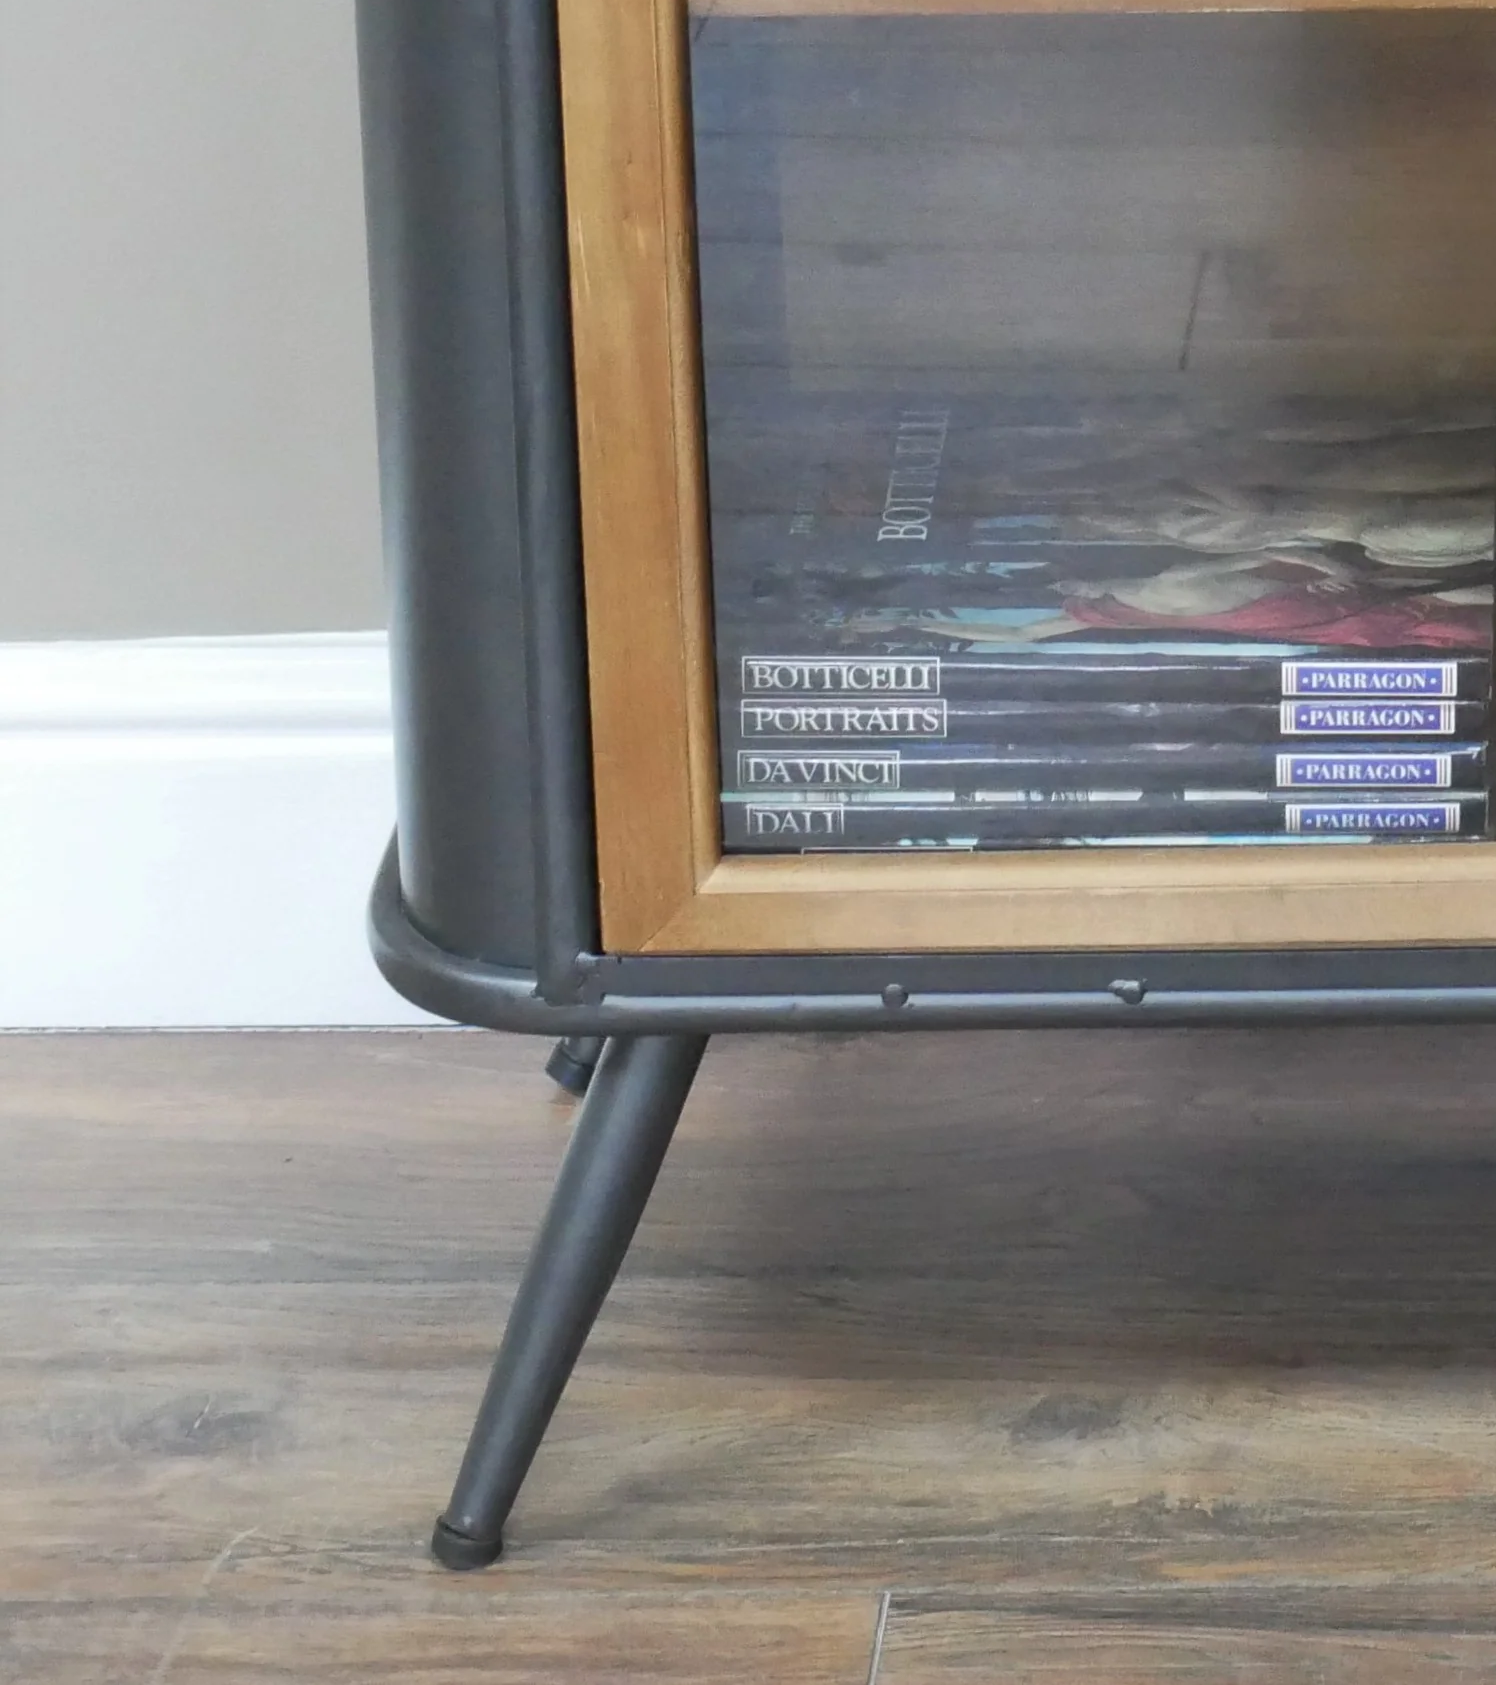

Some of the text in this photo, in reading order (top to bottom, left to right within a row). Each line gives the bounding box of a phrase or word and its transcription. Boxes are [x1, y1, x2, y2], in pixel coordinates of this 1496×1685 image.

[750, 664, 931, 690] BOTTICELLI
[1310, 672, 1427, 690] PARRAGON
[755, 707, 940, 732] PORTRAITS
[1309, 709, 1425, 728] PARRAGON
[748, 759, 894, 785] DA VINCI
[1305, 763, 1421, 781] PARRAGON
[753, 812, 836, 835] DALI
[1315, 812, 1430, 829] PARRAGON
